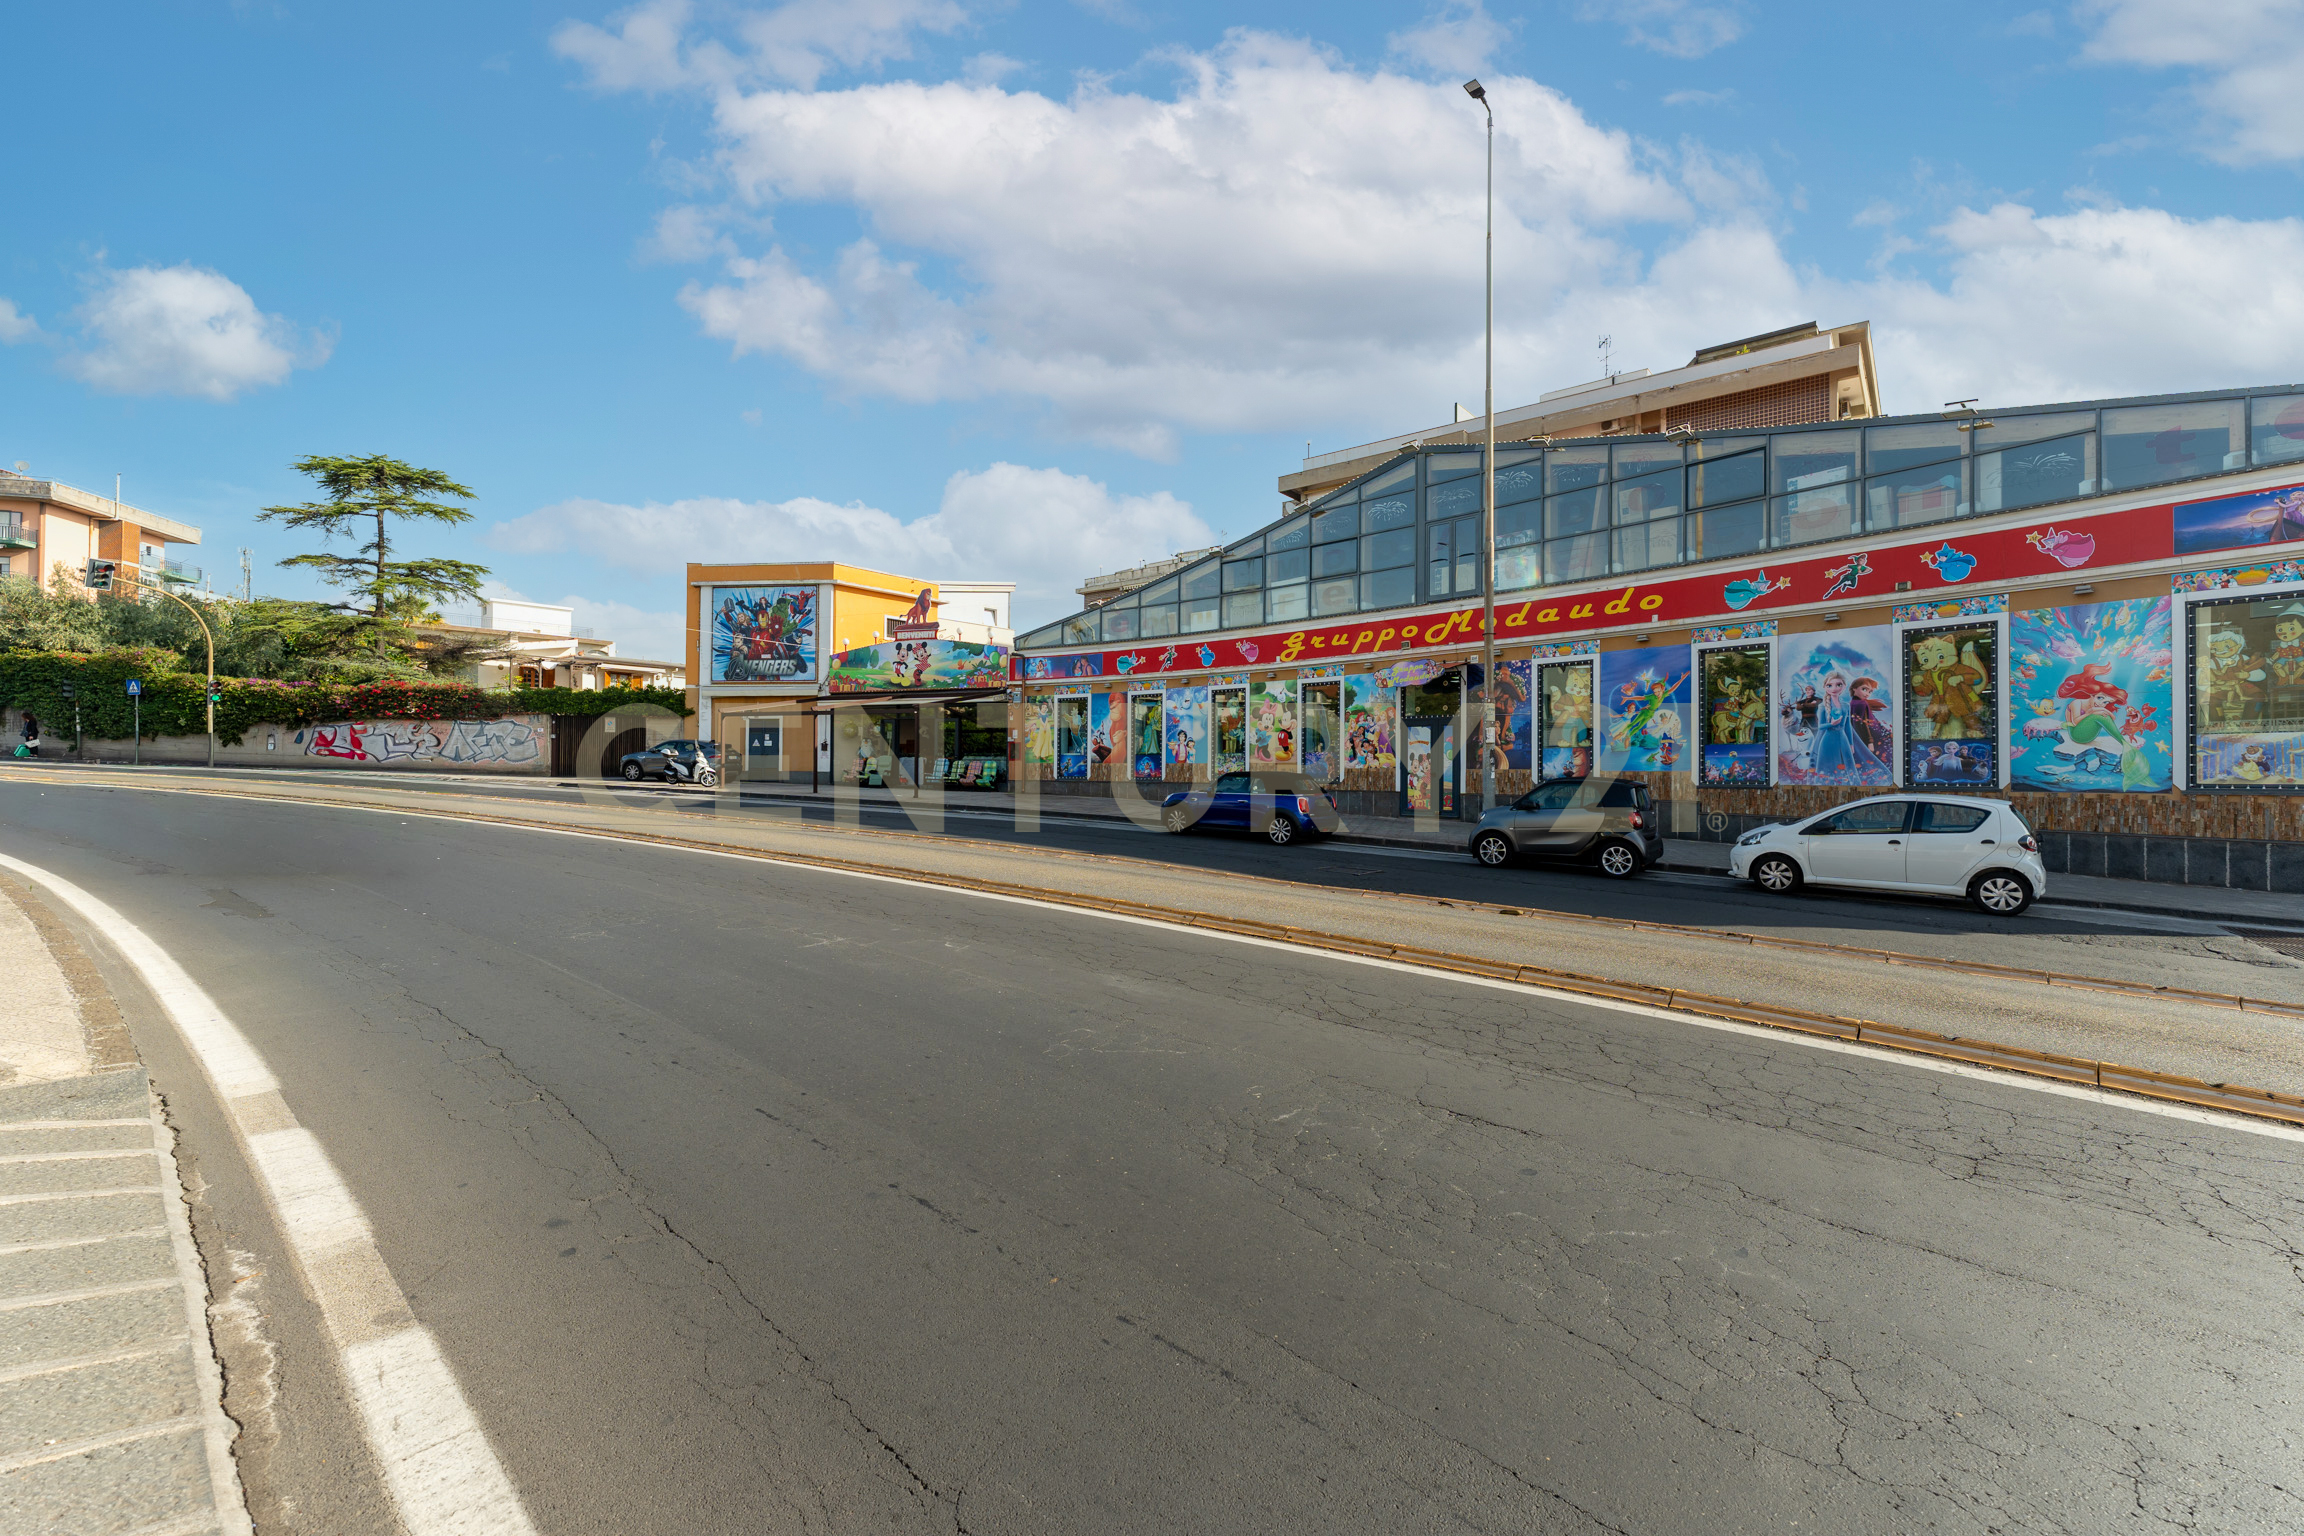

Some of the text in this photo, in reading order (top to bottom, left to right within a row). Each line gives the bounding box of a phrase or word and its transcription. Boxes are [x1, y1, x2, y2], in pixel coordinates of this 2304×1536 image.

[1280, 587, 1664, 662] Gruppo Modaudo
[897, 631, 935, 640] BENVENUTI
[727, 654, 797, 680] AVENGERS
[1391, 664, 1424, 677] Gruppo
[1388, 672, 1430, 686] Modaudo
